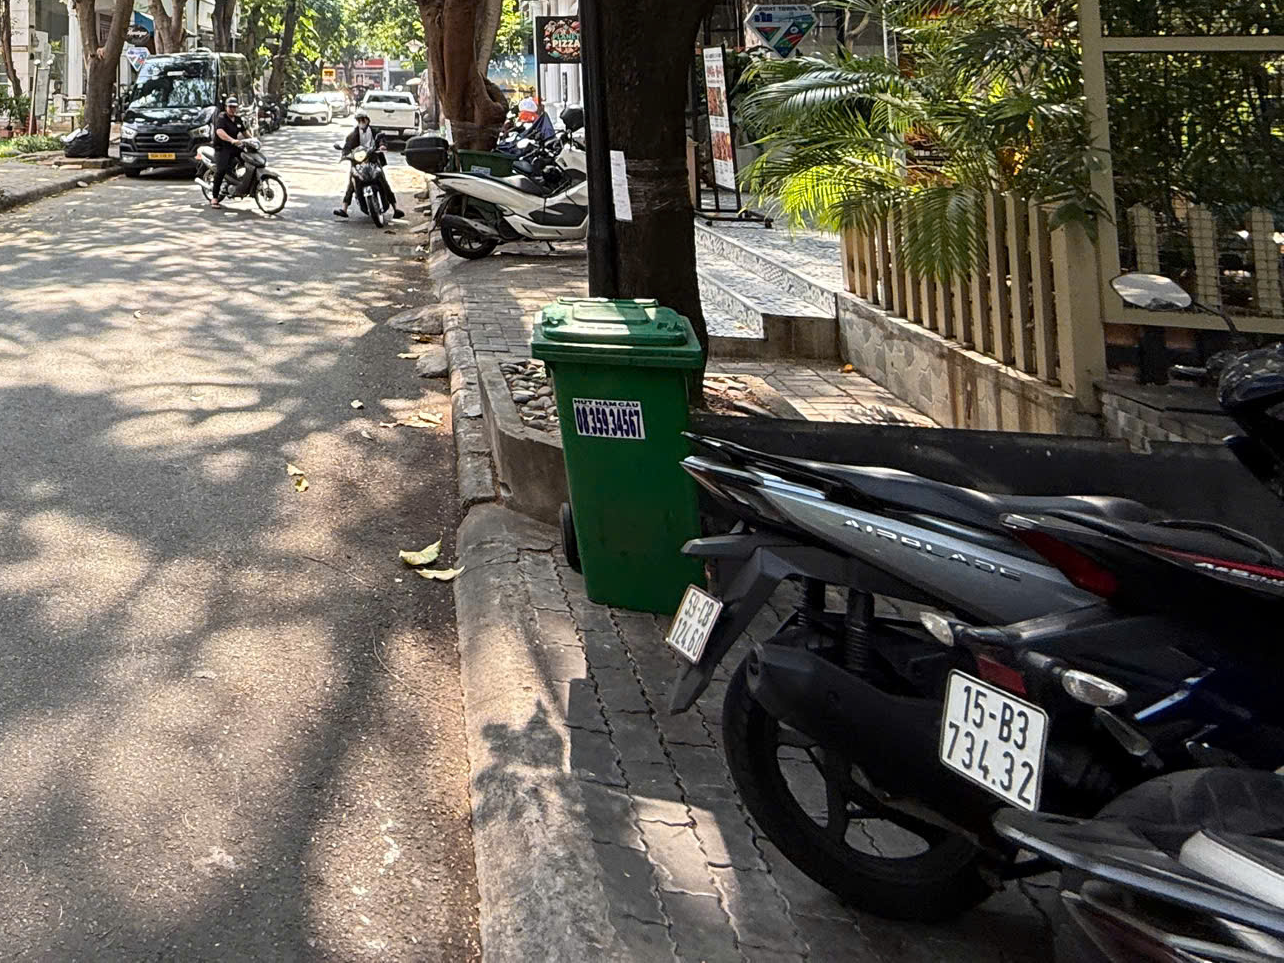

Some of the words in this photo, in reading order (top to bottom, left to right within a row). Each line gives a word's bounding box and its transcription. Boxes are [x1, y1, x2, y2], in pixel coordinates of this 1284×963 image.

[552, 39, 580, 48] PIZZA
[963, 685, 1029, 750] 15-B3
[947, 720, 1034, 805] 734.32
